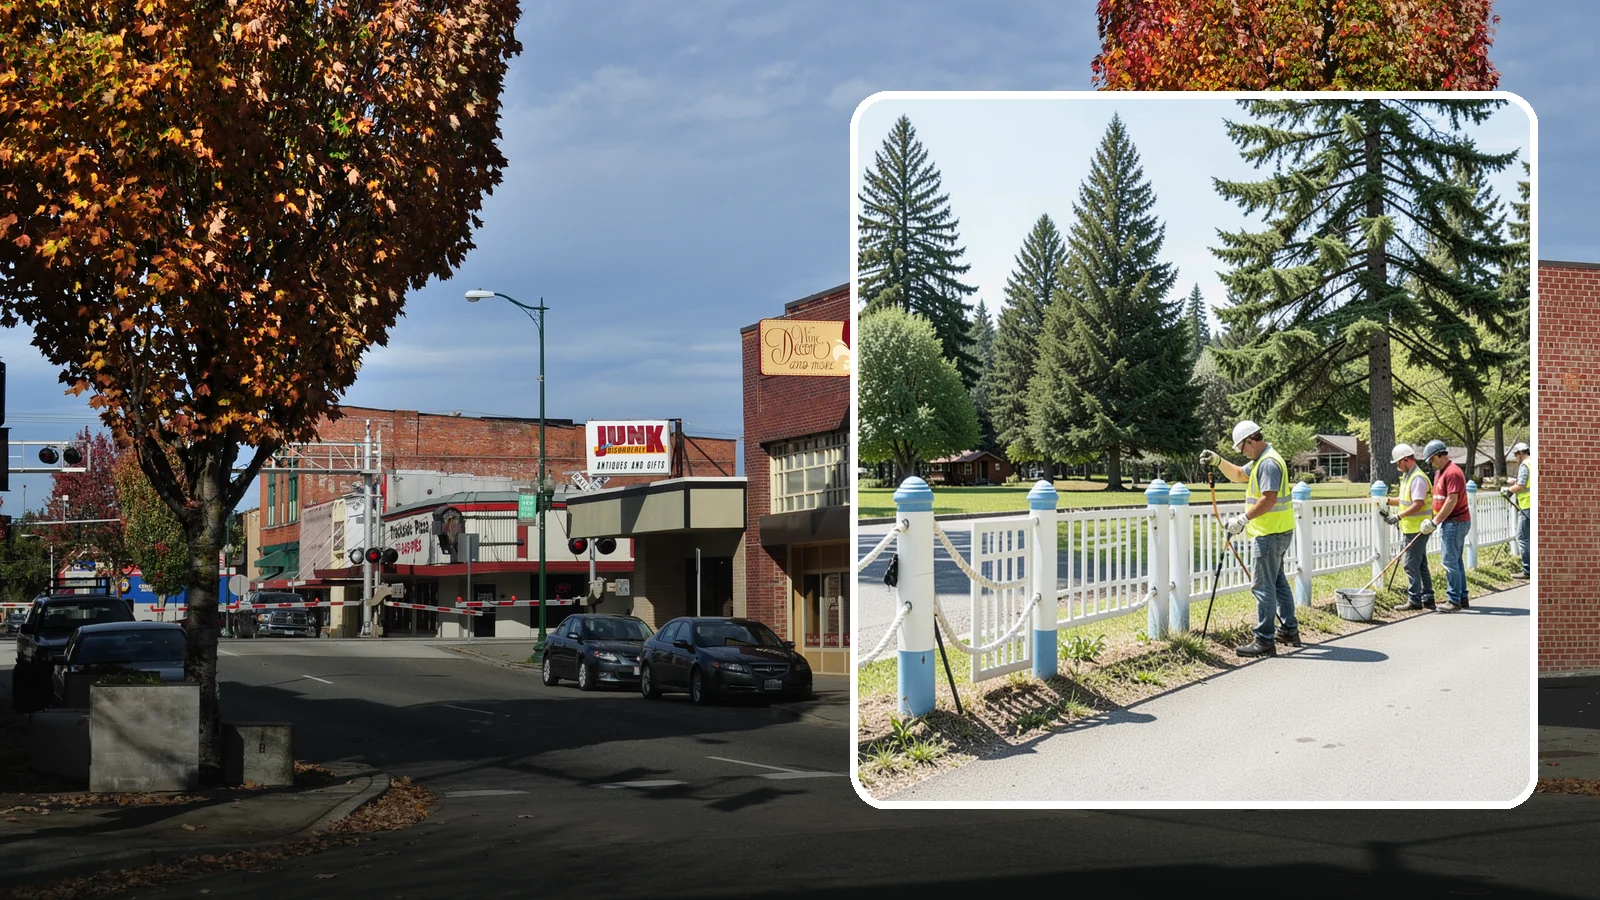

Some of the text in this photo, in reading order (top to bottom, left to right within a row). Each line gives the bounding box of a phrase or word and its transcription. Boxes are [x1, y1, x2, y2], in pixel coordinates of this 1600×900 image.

[596, 425, 665, 457] JUNK
[607, 446, 646, 454] DISORDERLY
[597, 460, 665, 470] ANTIQUES AND GIFTS
[590, 476, 608, 491] SING
[414, 519, 429, 535] Pizza
